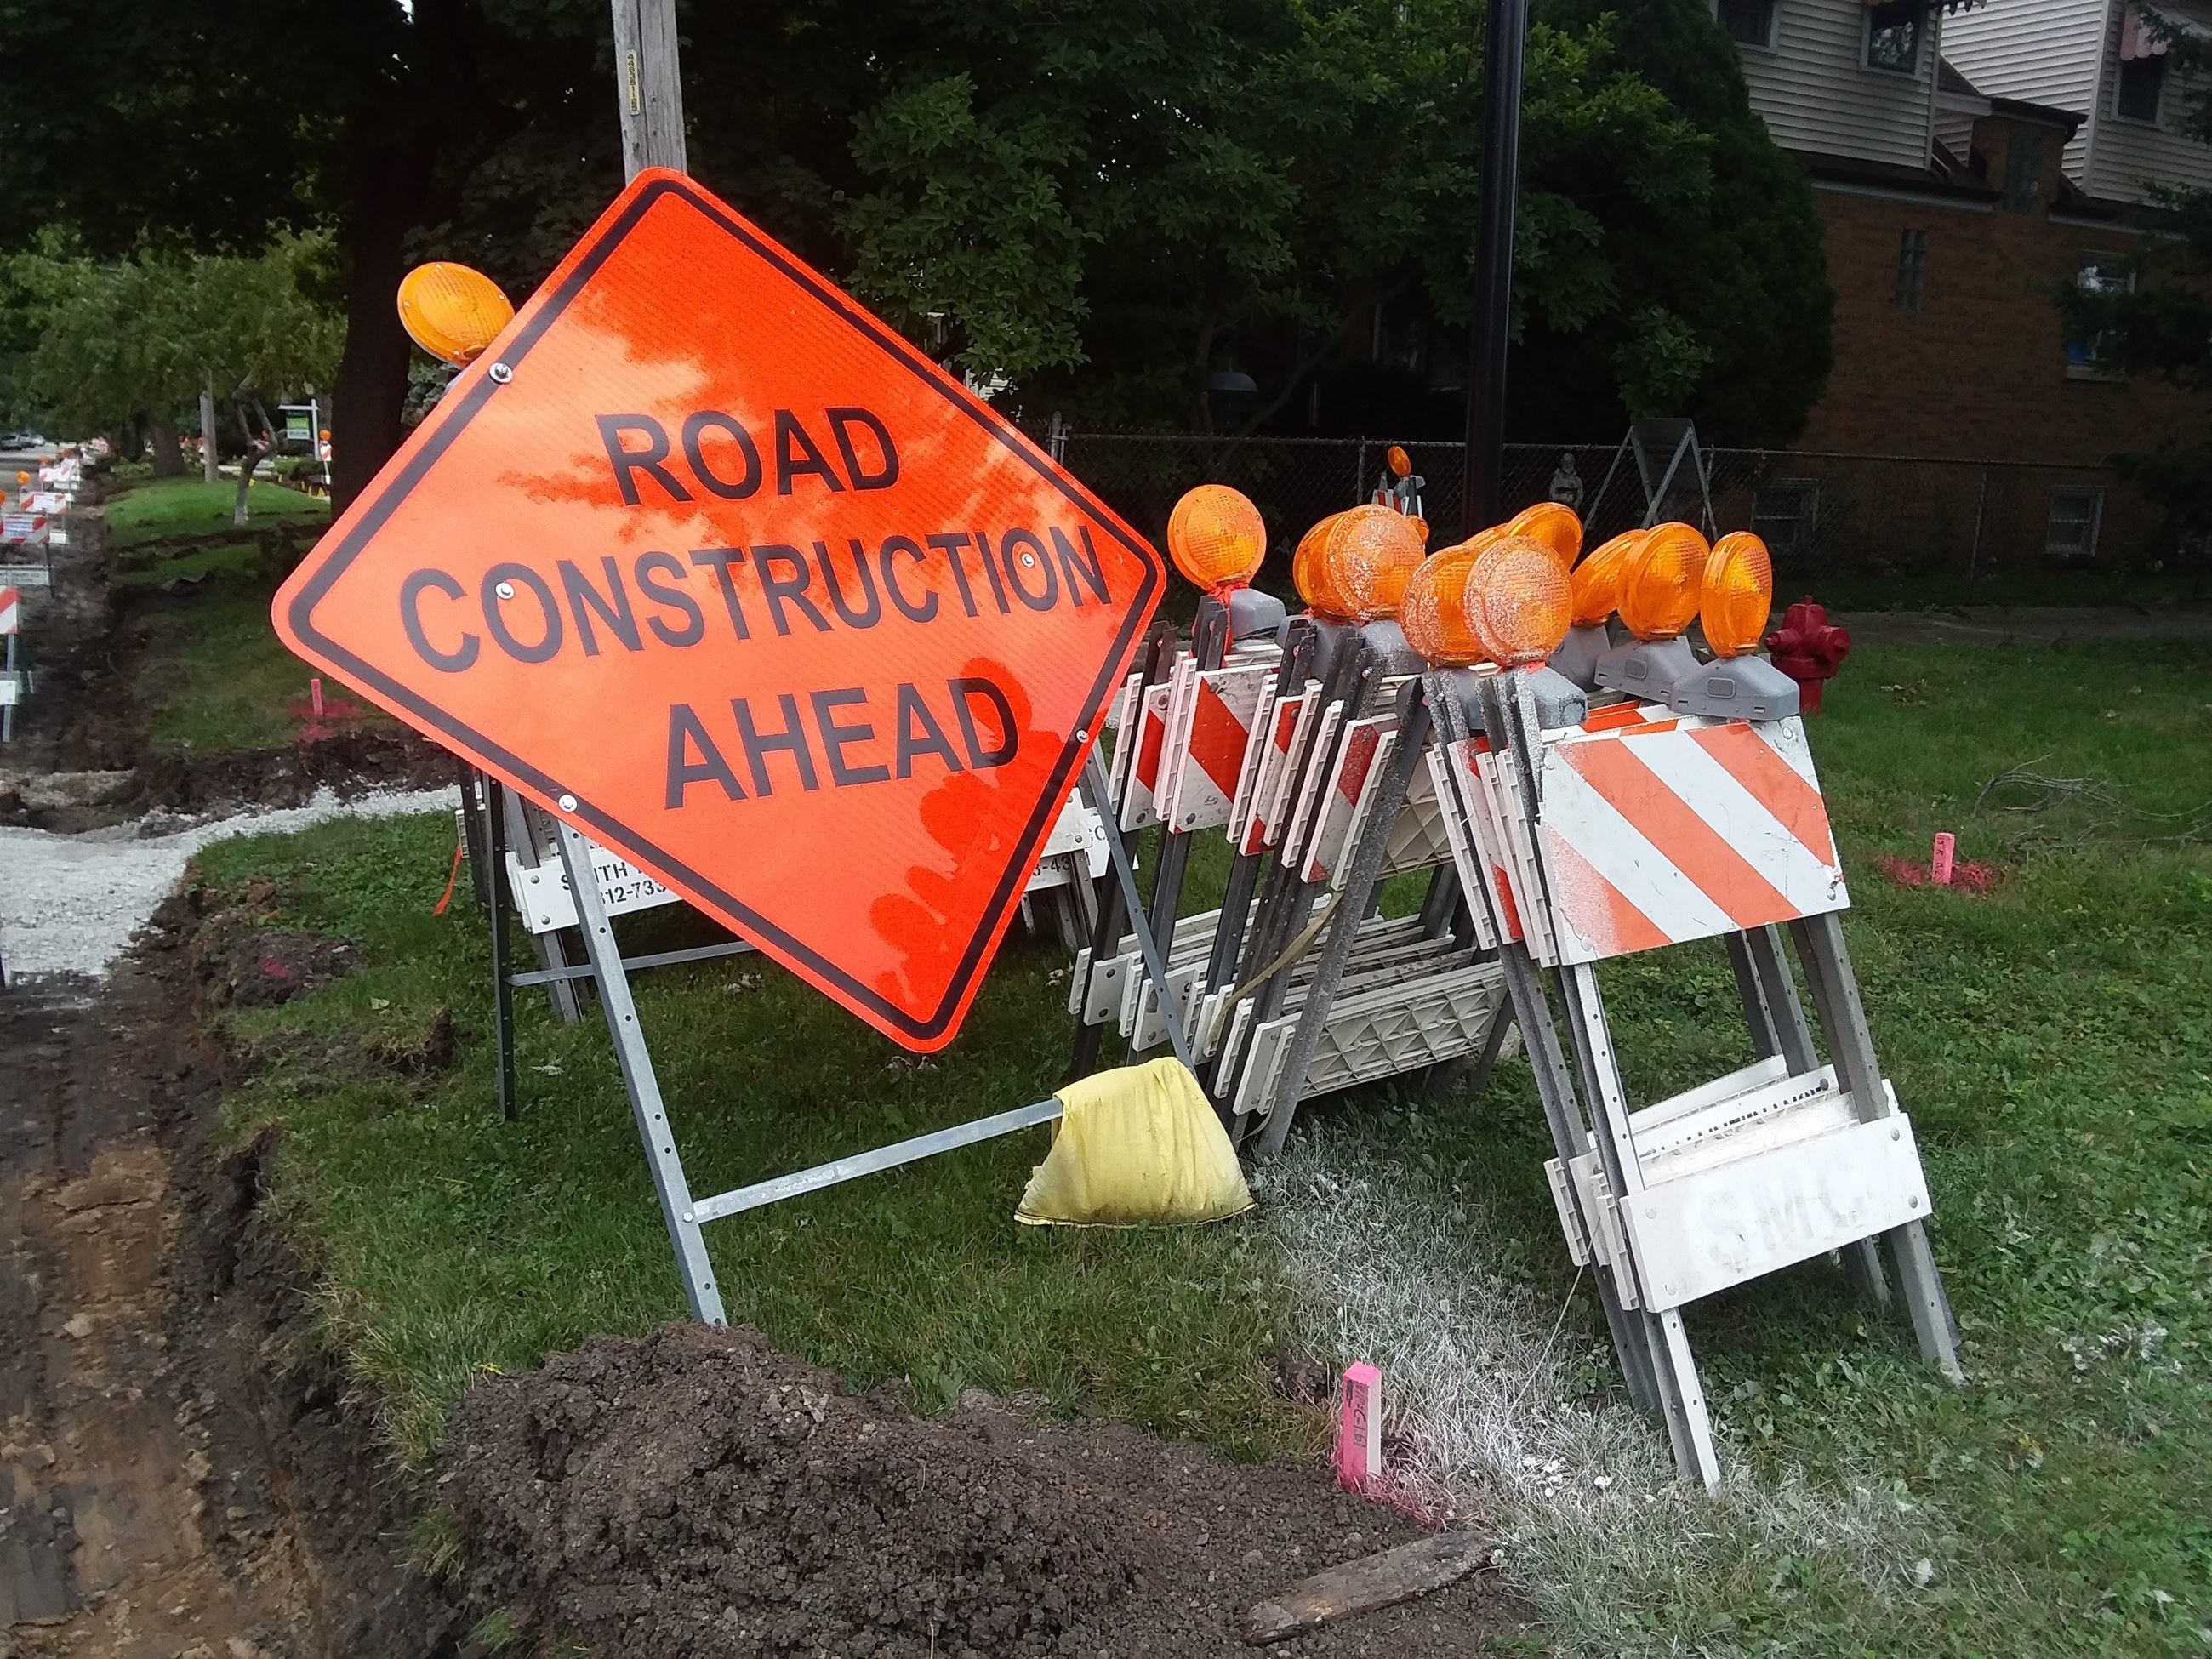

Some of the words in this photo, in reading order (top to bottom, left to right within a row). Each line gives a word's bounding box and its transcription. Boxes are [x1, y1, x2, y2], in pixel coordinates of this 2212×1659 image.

[596, 408, 900, 505] ROAD
[399, 525, 1112, 673] CONSTRUCTION
[664, 676, 1019, 810] AHEAD
